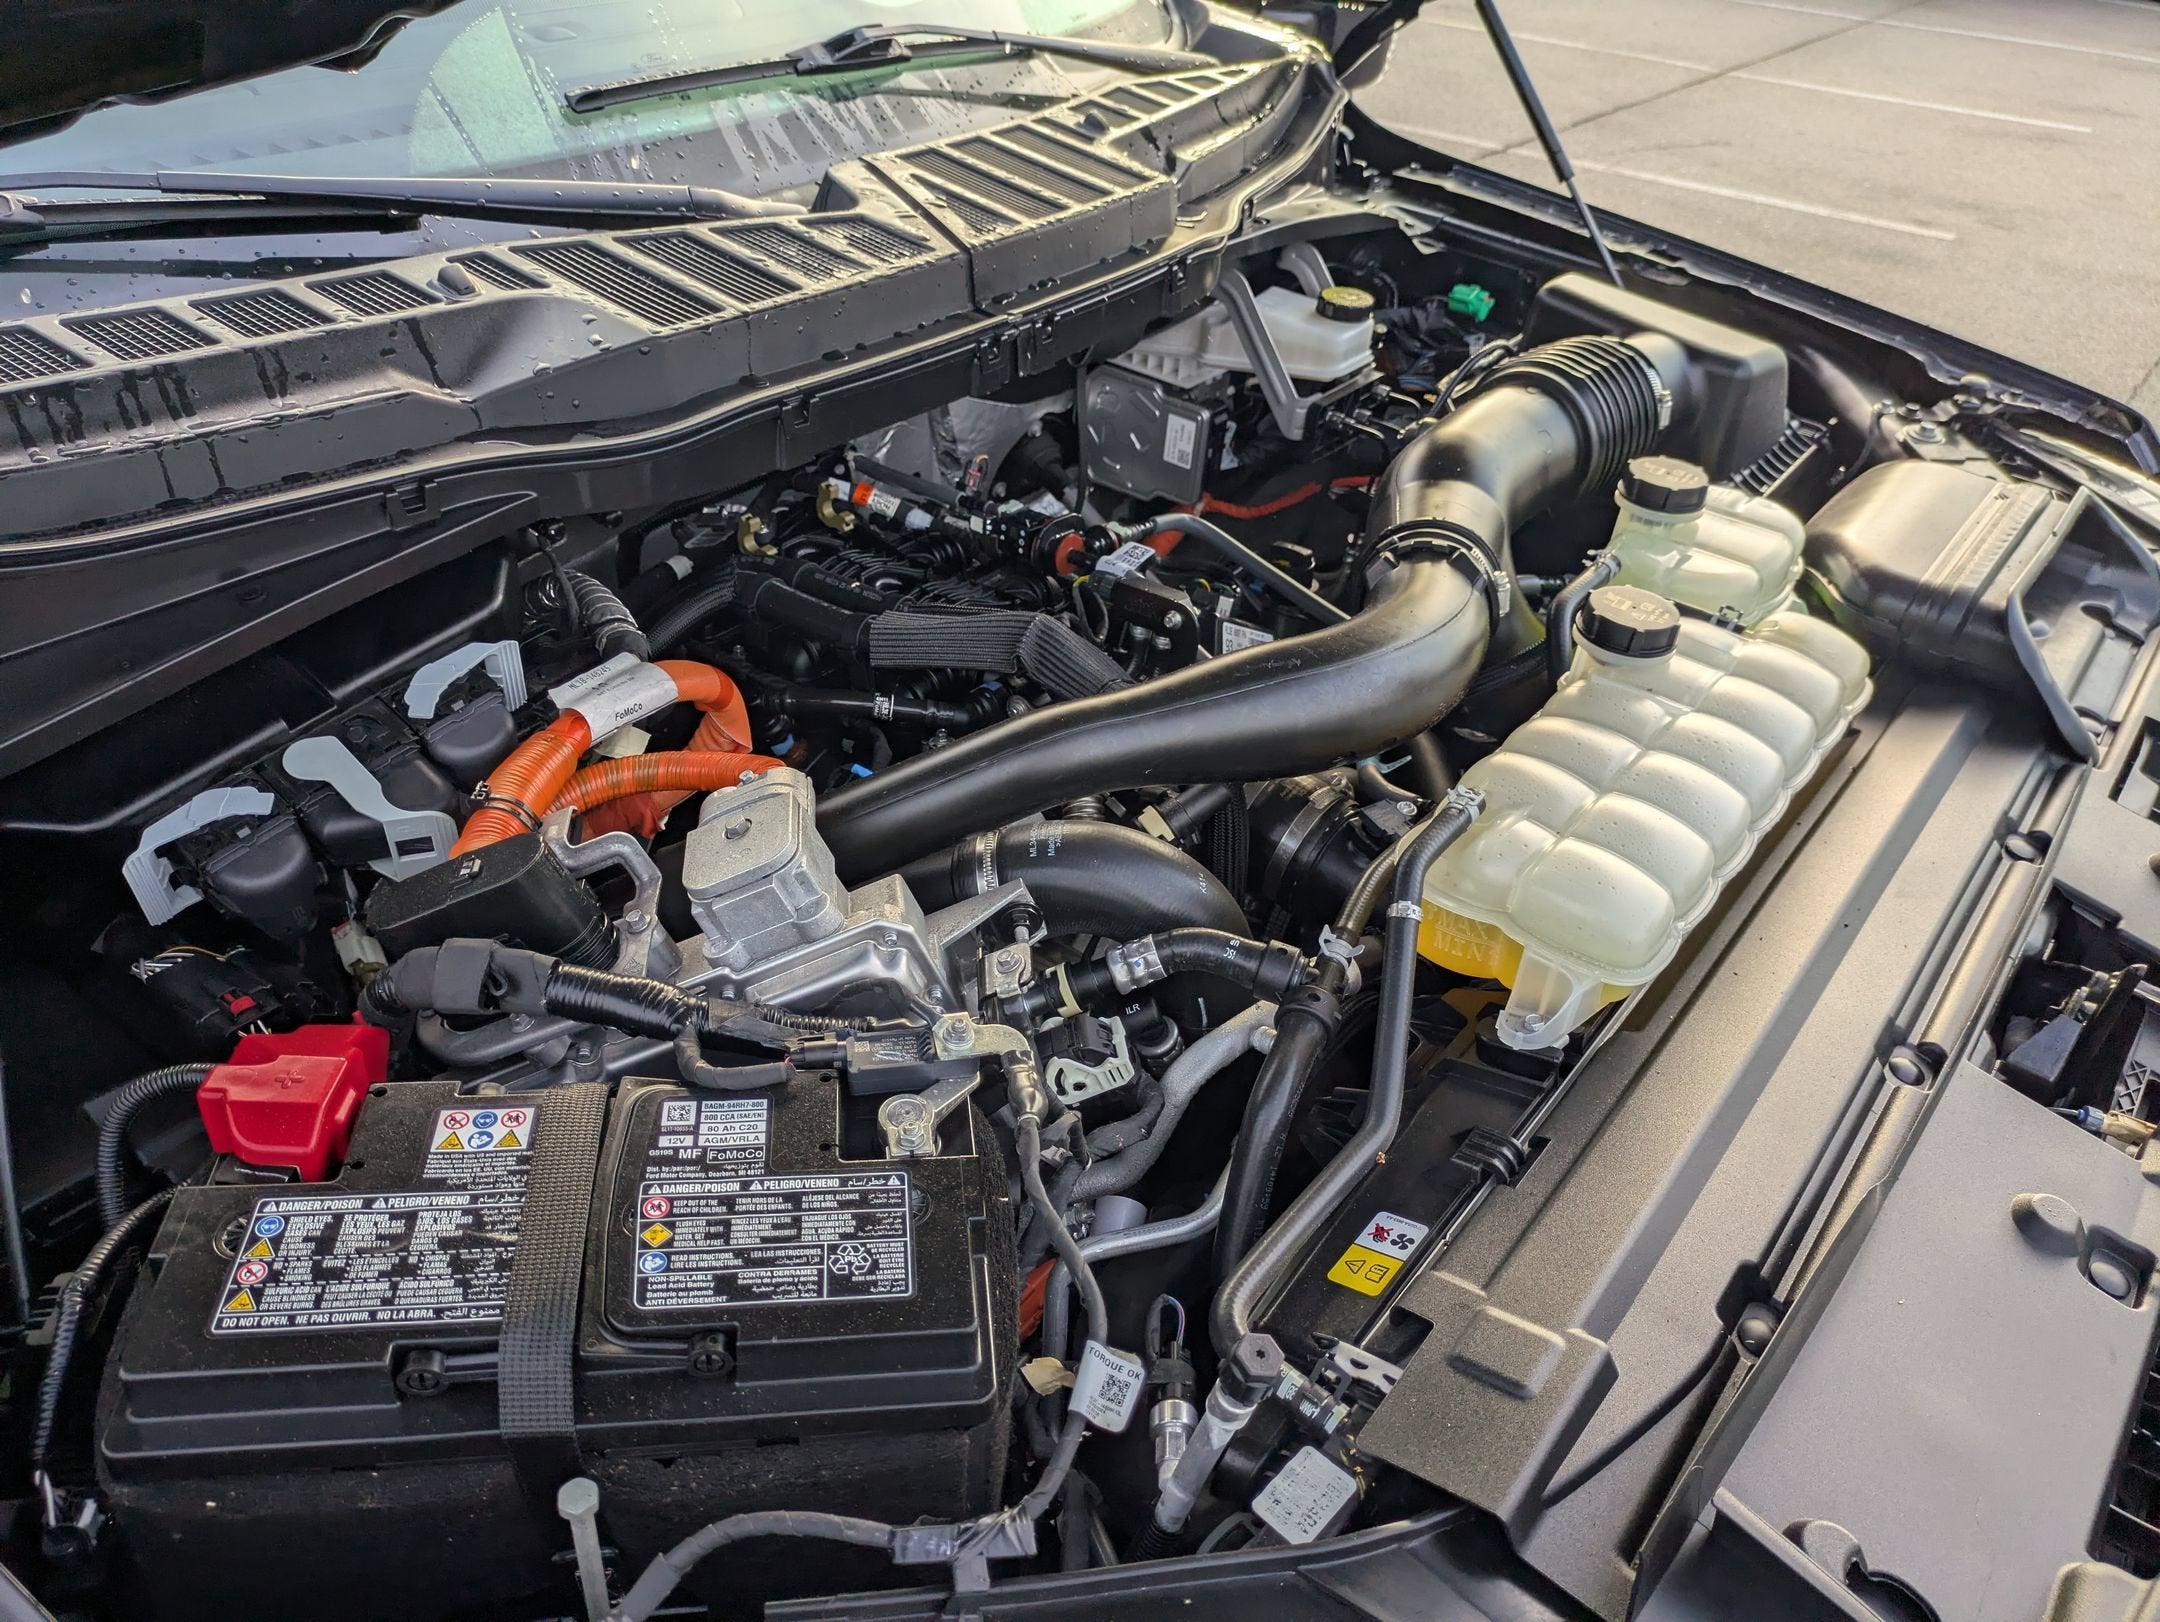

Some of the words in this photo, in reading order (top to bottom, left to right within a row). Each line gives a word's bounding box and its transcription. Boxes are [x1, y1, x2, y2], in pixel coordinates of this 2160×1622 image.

[615, 703, 642, 721] FoMoCo
[1440, 910, 1488, 940] MAX
[1434, 931, 1486, 961] MIN
[1126, 1004, 1140, 1015] ILR
[704, 1135, 760, 1144] AGM/VRLA
[679, 1149, 702, 1159] MF
[710, 1149, 763, 1160] FoMoCo
[662, 1182, 740, 1193] DANGER/POISON
[764, 1178, 839, 1190] PELIGRO/VENENO
[279, 1199, 363, 1211] DANGER/POISON
[388, 1195, 470, 1208] PELIGRO/VENENO
[289, 1216, 313, 1224] SHIELD
[354, 1213, 389, 1221] PROTÉGER
[451, 1216, 473, 1224] GASES
[288, 1222, 324, 1230] EXPLOSIVE
[280, 1242, 315, 1250] BLINDNESS
[288, 1249, 312, 1257] INJURY.
[689, 1252, 735, 1260] INSTRUCTIONS.
[289, 1260, 313, 1268] SPARKS
[408, 1256, 418, 1264] NO
[698, 1259, 744, 1267] INSTRUCTIONS.
[774, 1269, 818, 1277] DERRAMES
[648, 1275, 713, 1283] NON-SPILLABLE
[326, 1284, 349, 1292] L'ACIDE
[350, 1282, 390, 1291] SULFURIQUE
[687, 1281, 715, 1289] Battery
[265, 1287, 294, 1295] SULFURIC
[282, 1294, 315, 1302] BLINDNESS
[269, 1302, 291, 1310] SEVERE
[292, 1301, 314, 1309] BURNS.
[222, 1318, 239, 1327] DO
[240, 1317, 259, 1326] NOT
[261, 1316, 289, 1326] OPEN.
[296, 1315, 309, 1324] NE
[311, 1314, 330, 1323] PAS
[332, 1312, 371, 1322] OUVRIR.
[376, 1310, 391, 1320] NO
[393, 1310, 405, 1319] LA
[406, 1309, 436, 1319] ABRA.
[1088, 1347, 1125, 1374] TORQUE
[1127, 1370, 1141, 1380] OK
